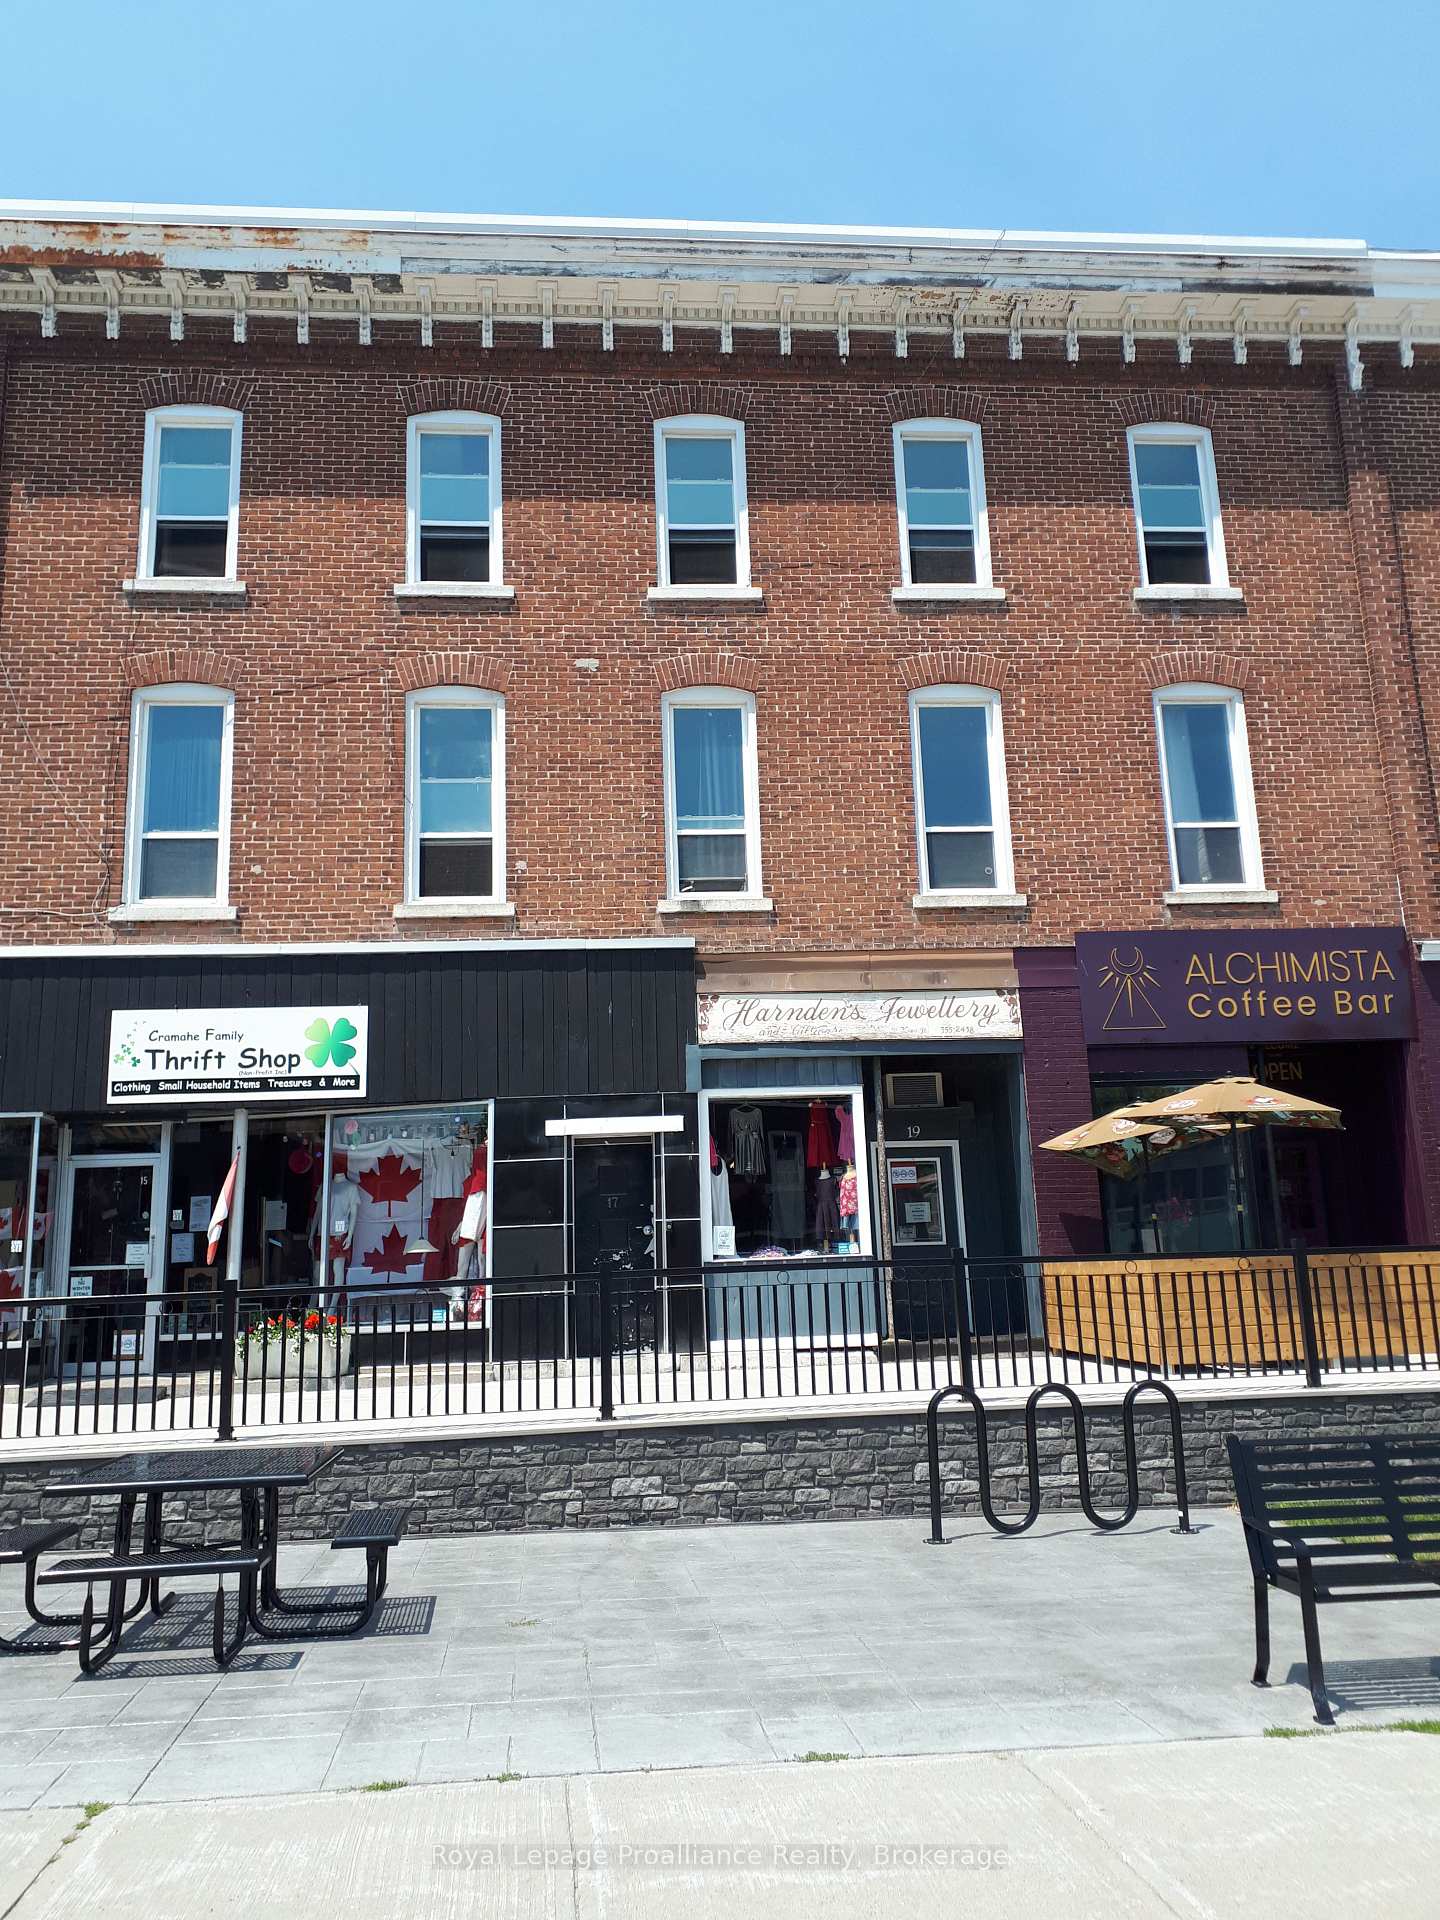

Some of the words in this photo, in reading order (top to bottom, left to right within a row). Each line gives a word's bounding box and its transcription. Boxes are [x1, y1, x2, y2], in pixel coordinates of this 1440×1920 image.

[1185, 949, 1396, 985] ALCHIMISTA
[1187, 989, 1317, 1018] Coffee
[1334, 990, 1394, 1016] Bar
[722, 997, 867, 1031] Harnden's
[873, 995, 1000, 1028] Jewellery
[148, 1030, 200, 1042] Cramahe
[205, 1028, 244, 1044] Family
[144, 1049, 226, 1071] Thrift
[238, 1048, 301, 1074] Shop
[113, 1083, 151, 1094] Clothing
[158, 1081, 183, 1091] Small
[186, 1080, 231, 1090] Household
[233, 1079, 261, 1089] Items
[267, 1078, 312, 1088] Treasures
[319, 1077, 326, 1087] &
[332, 1077, 356, 1087] More
[907, 1125, 920, 1138] 19
[140, 1176, 148, 1185] 15
[607, 1196, 619, 1208] 17
